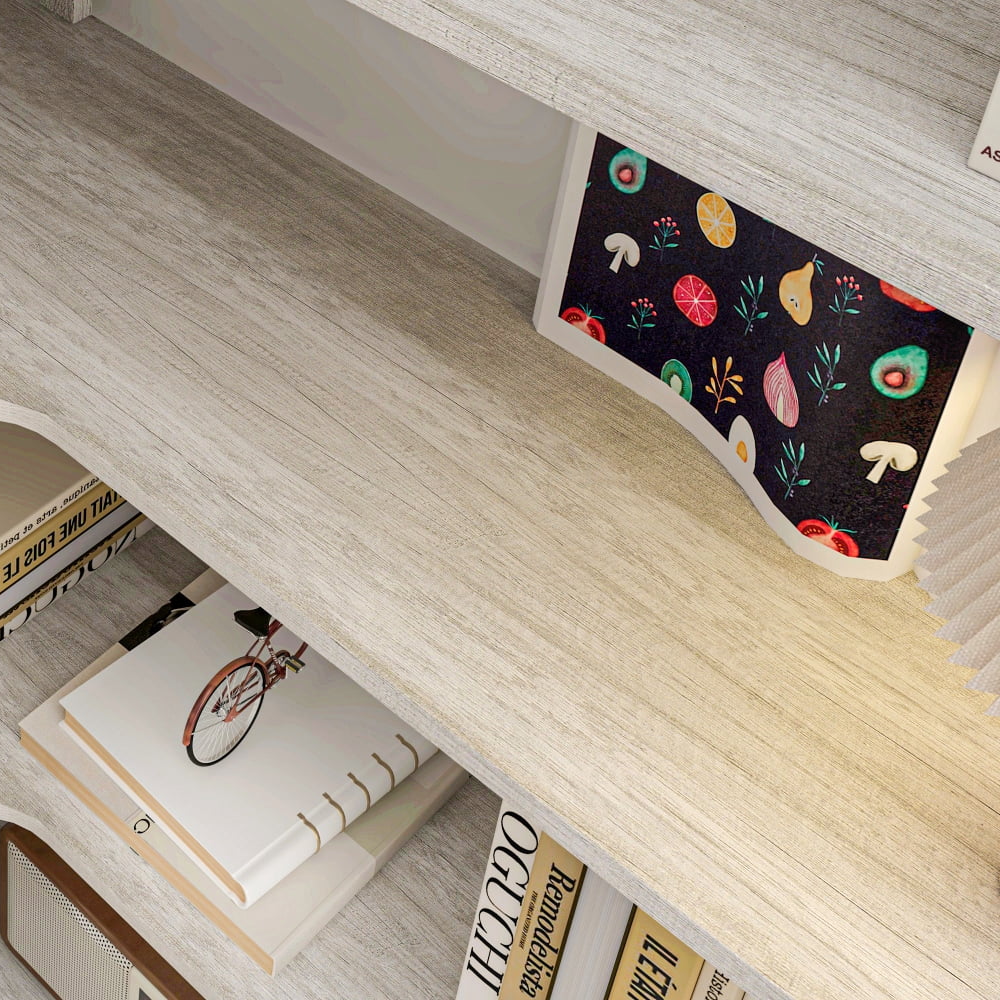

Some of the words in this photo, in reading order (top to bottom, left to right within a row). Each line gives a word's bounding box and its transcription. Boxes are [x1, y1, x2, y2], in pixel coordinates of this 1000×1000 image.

[467, 810, 540, 997] OGUCHI
[519, 862, 577, 999] Remodelista
[642, 933, 679, 967] IL
